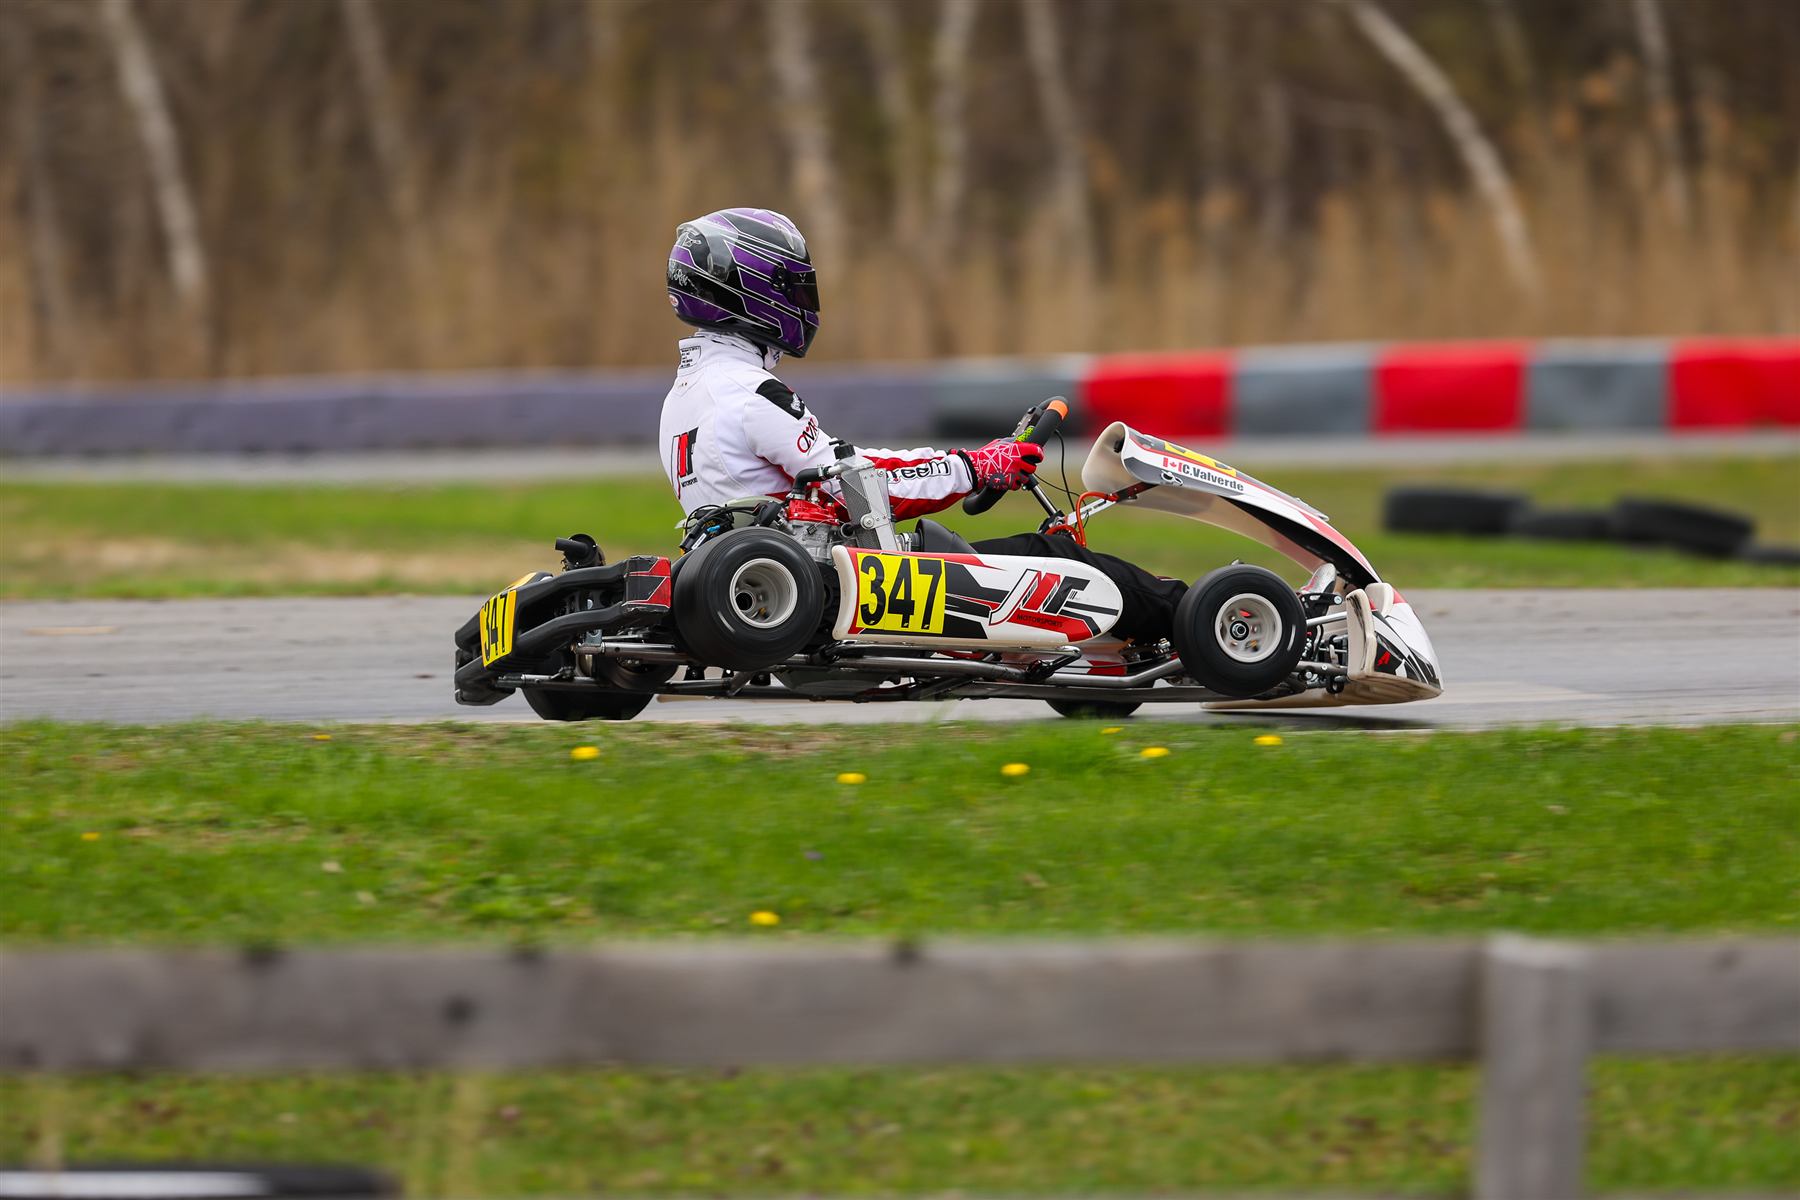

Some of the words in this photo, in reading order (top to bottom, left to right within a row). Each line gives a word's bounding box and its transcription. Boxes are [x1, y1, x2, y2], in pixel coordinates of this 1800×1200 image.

[886, 461, 950, 479] reem
[1183, 464, 1244, 491] C.Valverde
[860, 555, 942, 630] 347
[482, 593, 508, 662] 347
